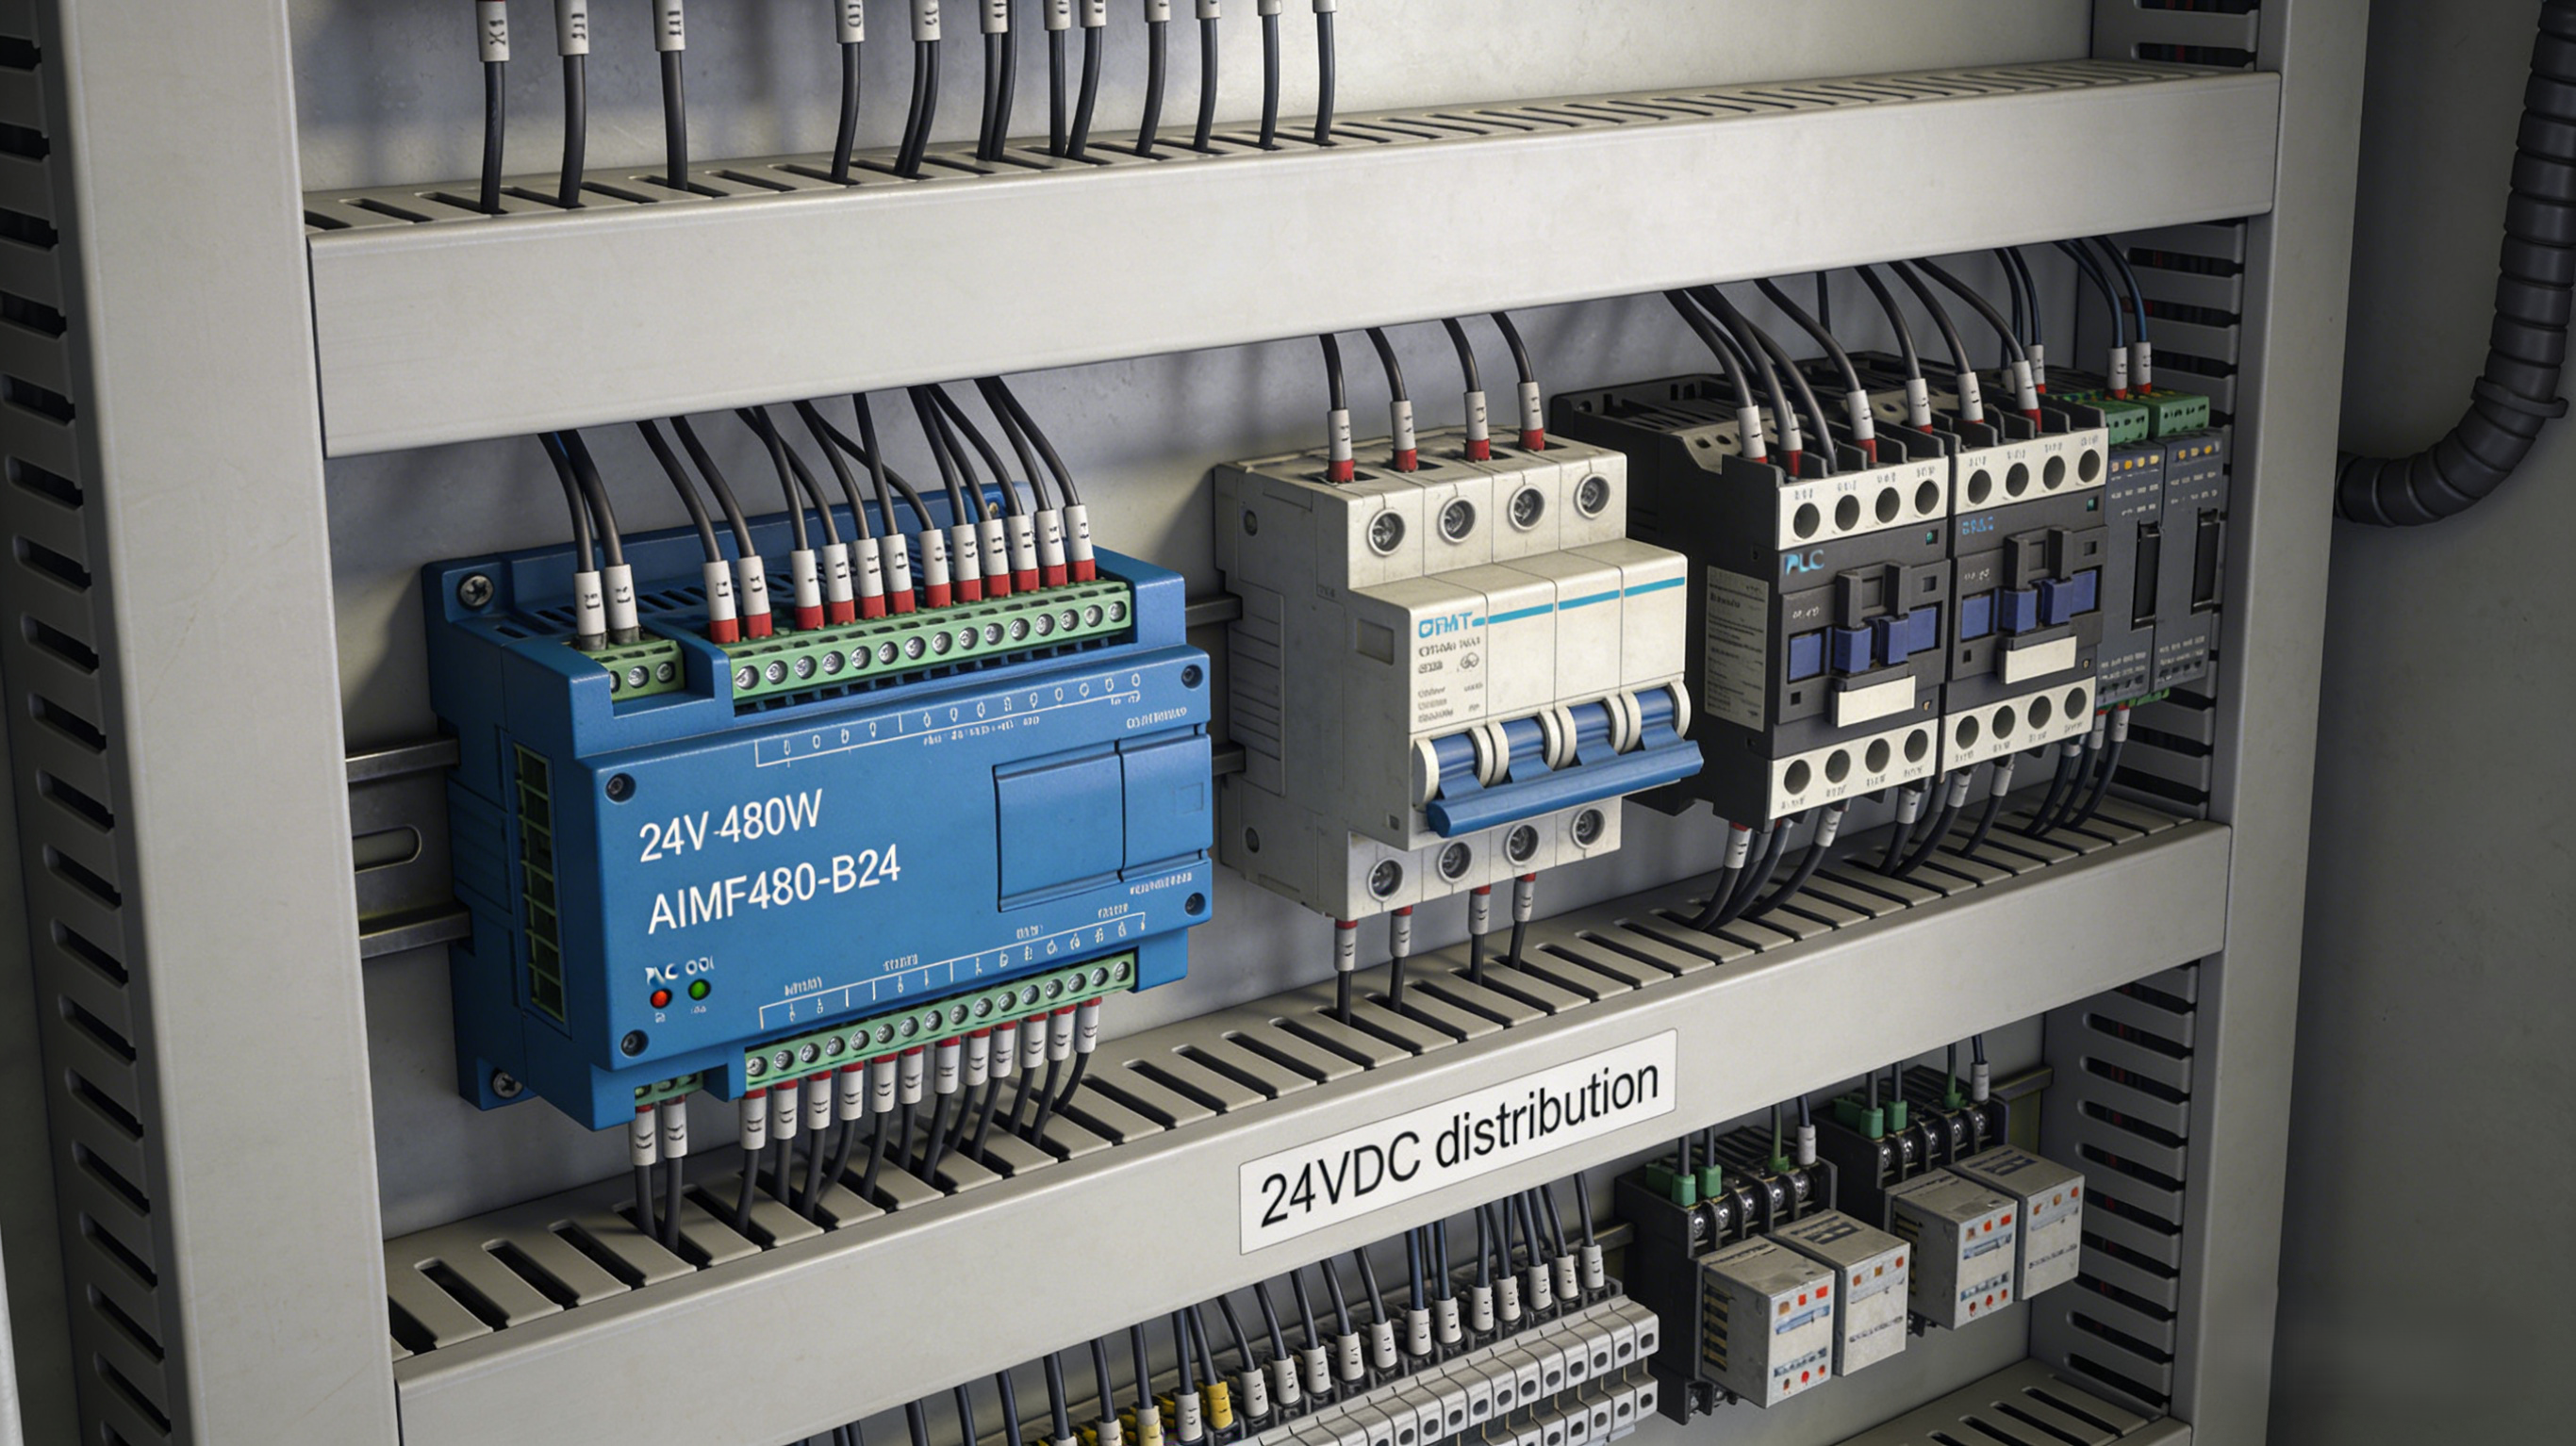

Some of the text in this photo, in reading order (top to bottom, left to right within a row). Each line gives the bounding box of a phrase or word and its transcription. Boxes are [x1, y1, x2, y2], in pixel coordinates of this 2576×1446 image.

[647, 843, 901, 935] AIMF480-B24
[1260, 1063, 1660, 1228] 24VDC distribution
